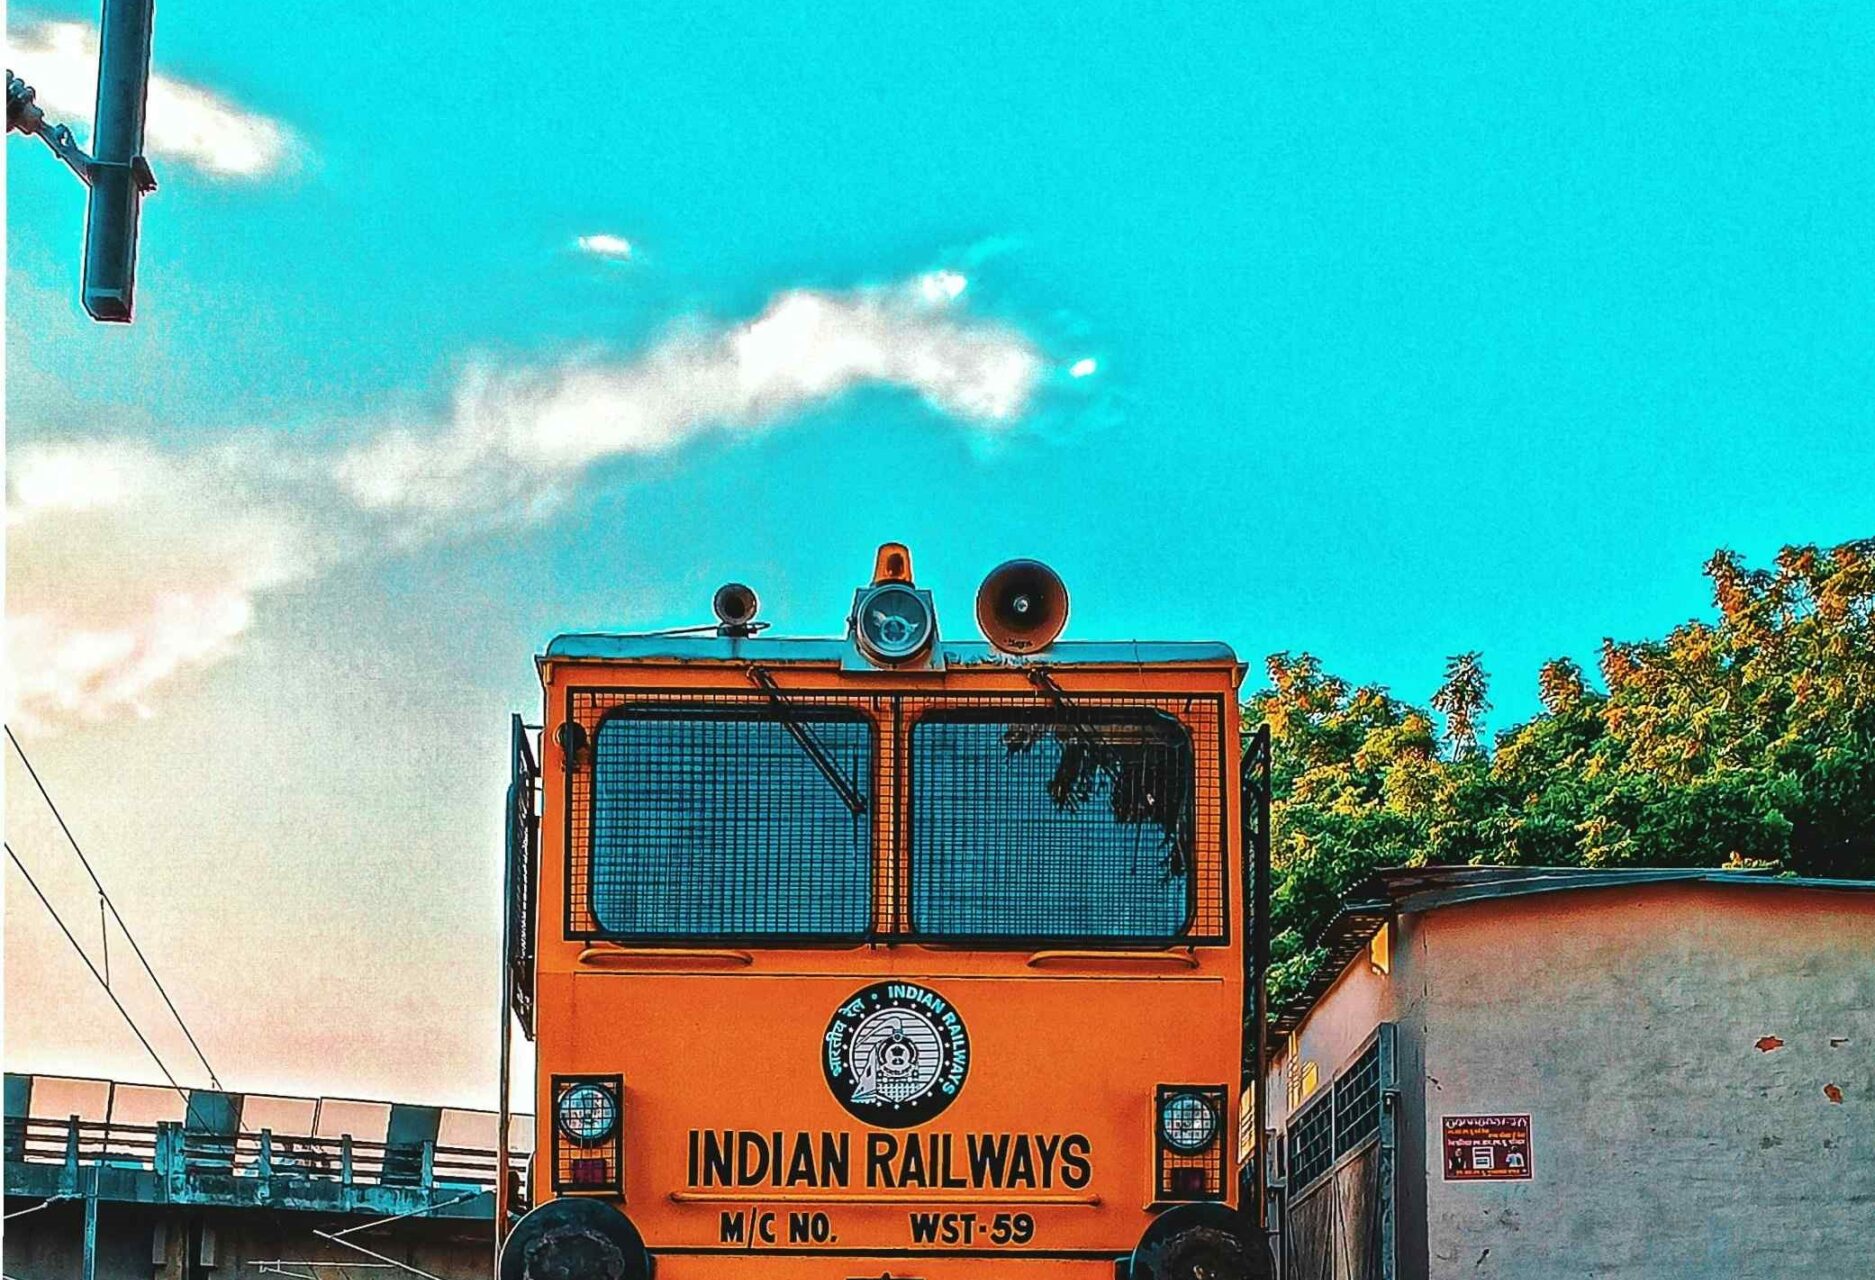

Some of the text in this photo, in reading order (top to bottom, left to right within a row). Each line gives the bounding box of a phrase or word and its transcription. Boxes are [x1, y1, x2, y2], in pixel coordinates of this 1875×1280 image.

[826, 998, 865, 1077] भारतीय रेल
[888, 985, 966, 1095] INDIAN RAILWAYS
[688, 1130, 1091, 1189] INDIAN RAILWAYS
[720, 1207, 1034, 1248] M/C NO. WST-59
